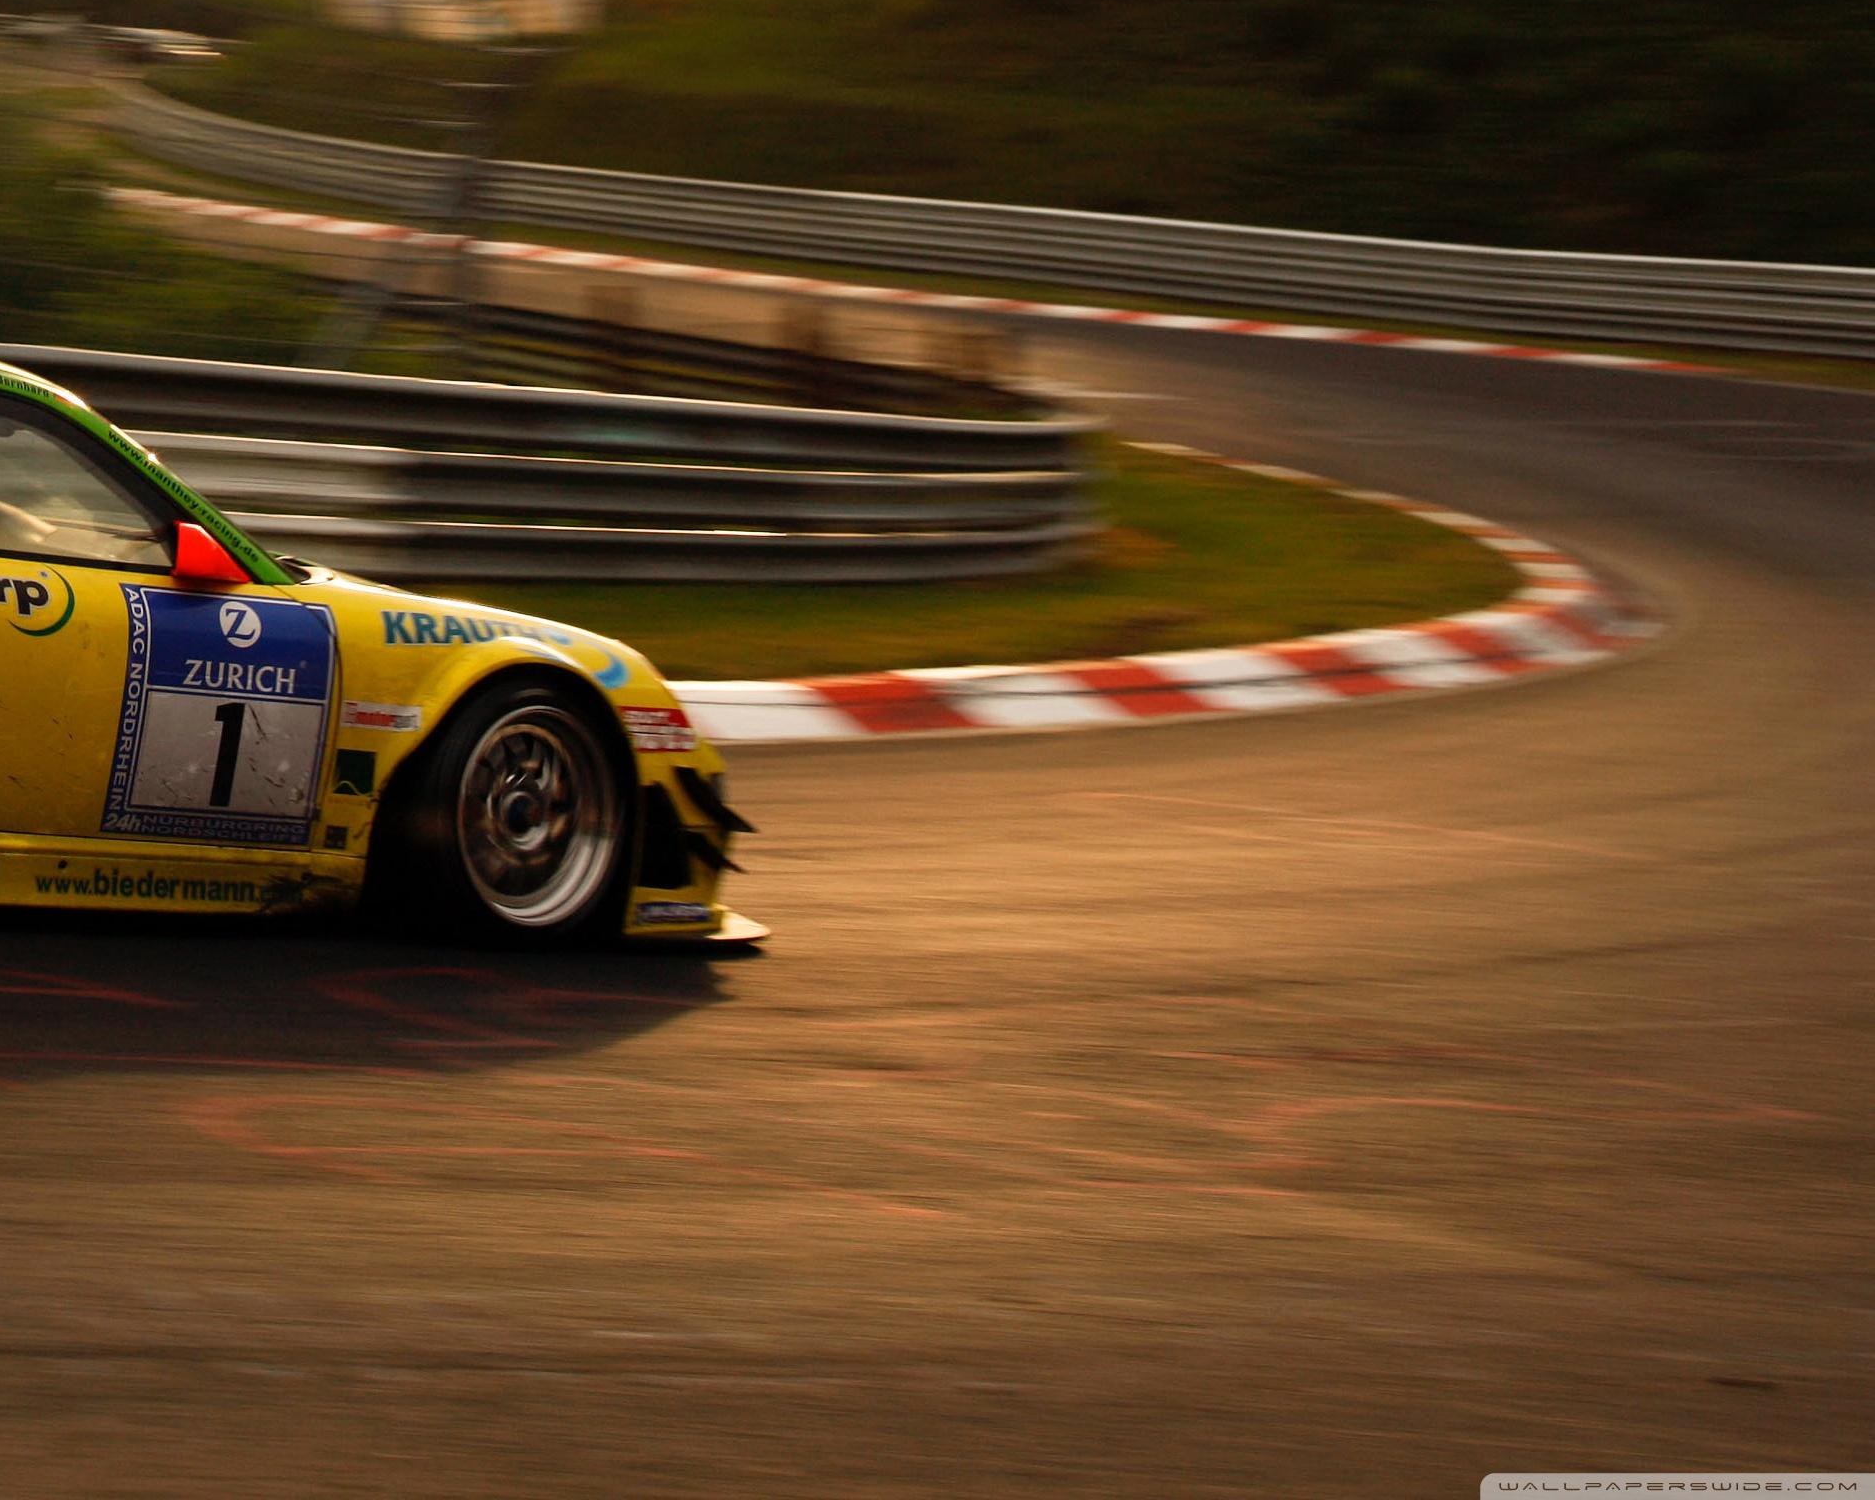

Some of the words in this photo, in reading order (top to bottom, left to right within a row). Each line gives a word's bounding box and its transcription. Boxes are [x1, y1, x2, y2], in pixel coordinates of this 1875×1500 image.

[125, 587, 146, 655] ADAC
[183, 659, 296, 694] ZURICH
[109, 662, 146, 811] NORDRHEIN
[209, 702, 246, 807] 1
[106, 812, 142, 833] 24h
